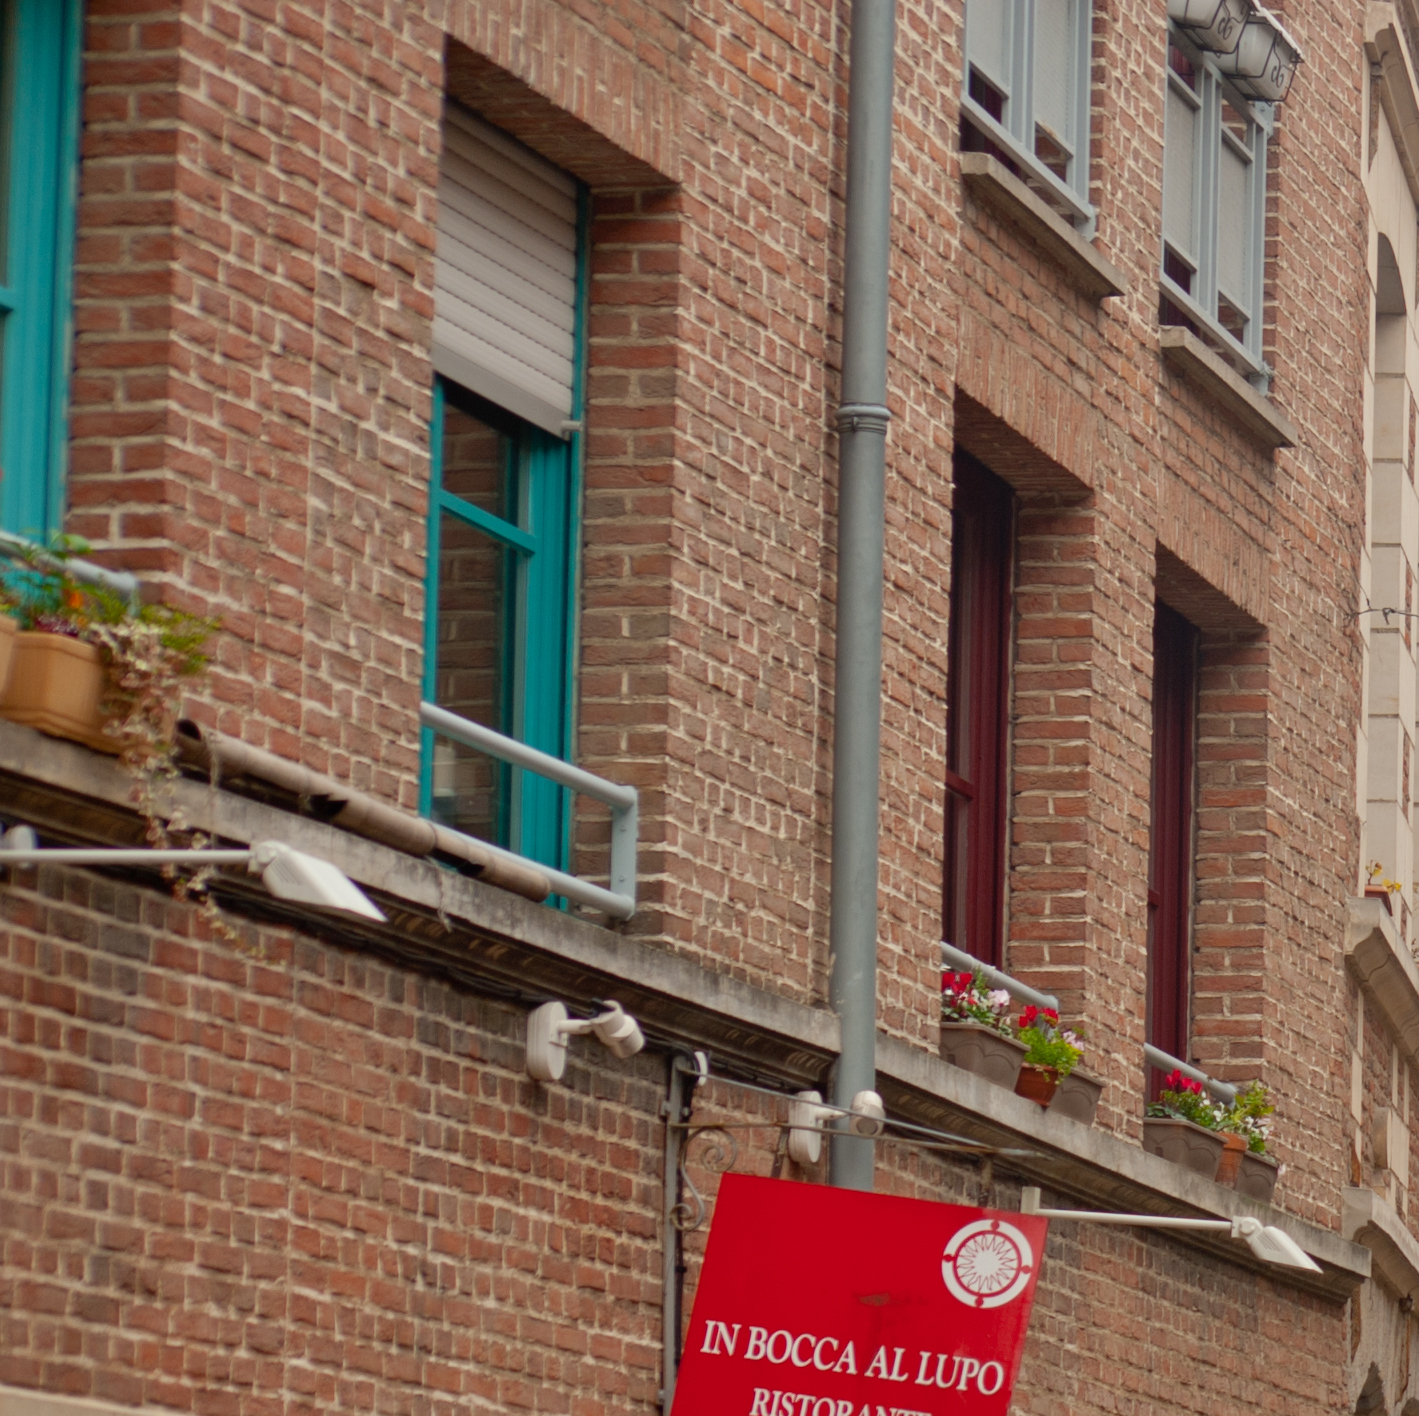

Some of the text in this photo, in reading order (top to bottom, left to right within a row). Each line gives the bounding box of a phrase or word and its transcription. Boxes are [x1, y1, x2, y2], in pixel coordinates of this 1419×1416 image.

[700, 1319, 1005, 1396] IN BOCCA AL LUPO
